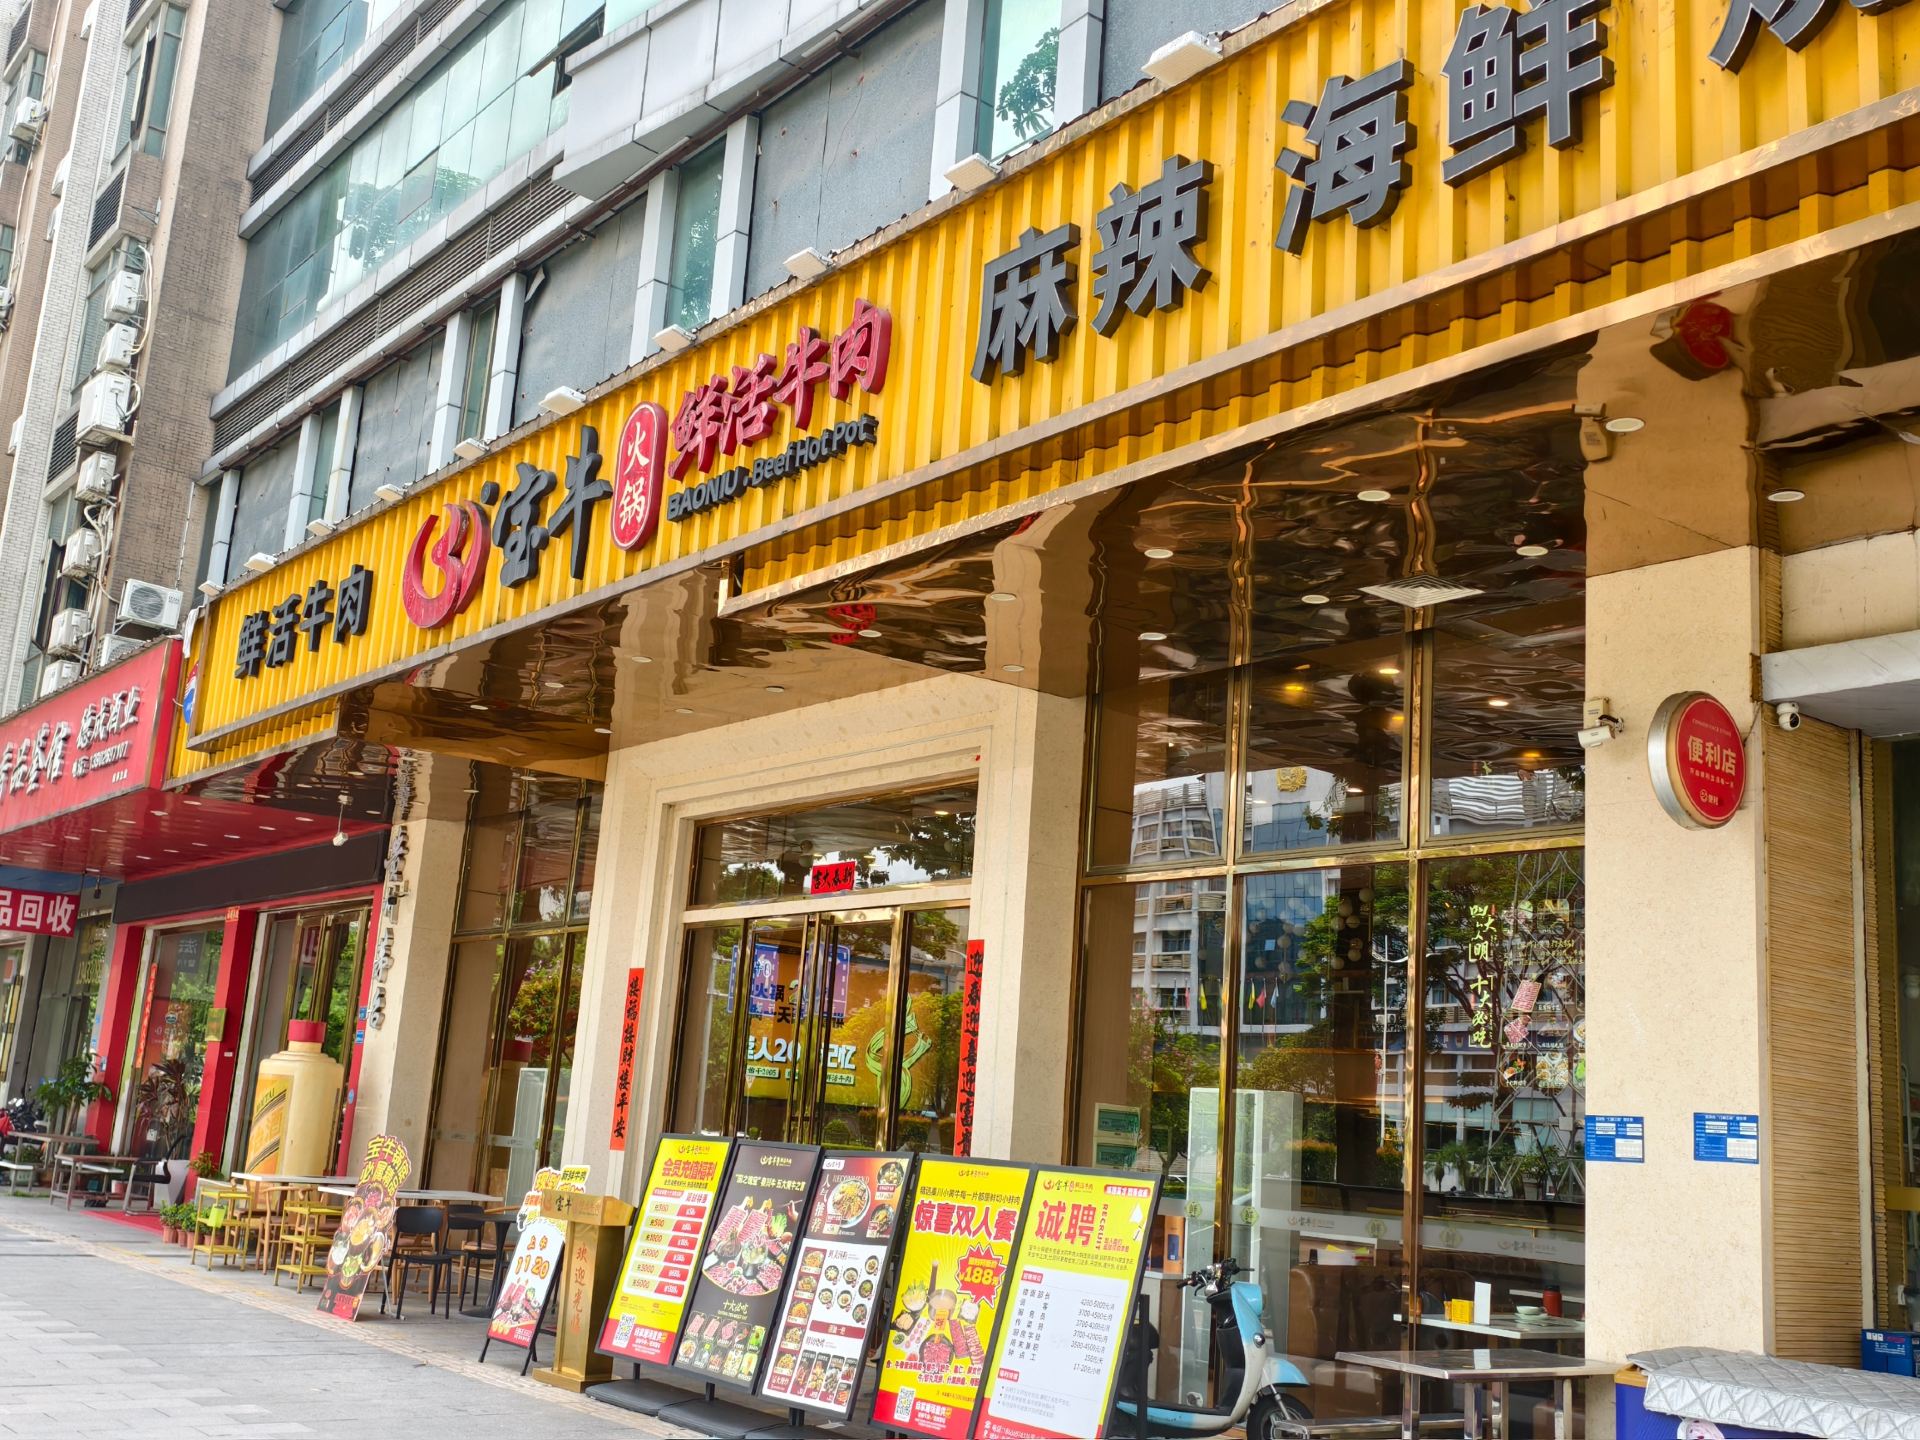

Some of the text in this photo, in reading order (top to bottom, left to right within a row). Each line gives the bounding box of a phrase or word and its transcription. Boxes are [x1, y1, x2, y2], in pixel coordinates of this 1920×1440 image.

[668, 297, 892, 481] 鲜活牛肉
[619, 421, 650, 531] 火锅
[667, 414, 880, 522] BAONIU Beef Hot Pot
[234, 564, 374, 679] 鲜活牛肉
[1687, 735, 1737, 777] 便利店
[662, 1158, 717, 1181] 会员充值福利
[914, 1199, 1018, 1242] 惊喜双人餐
[1035, 1200, 1097, 1247] 诚聘
[1096, 1203, 1109, 1251] RECRUIT
